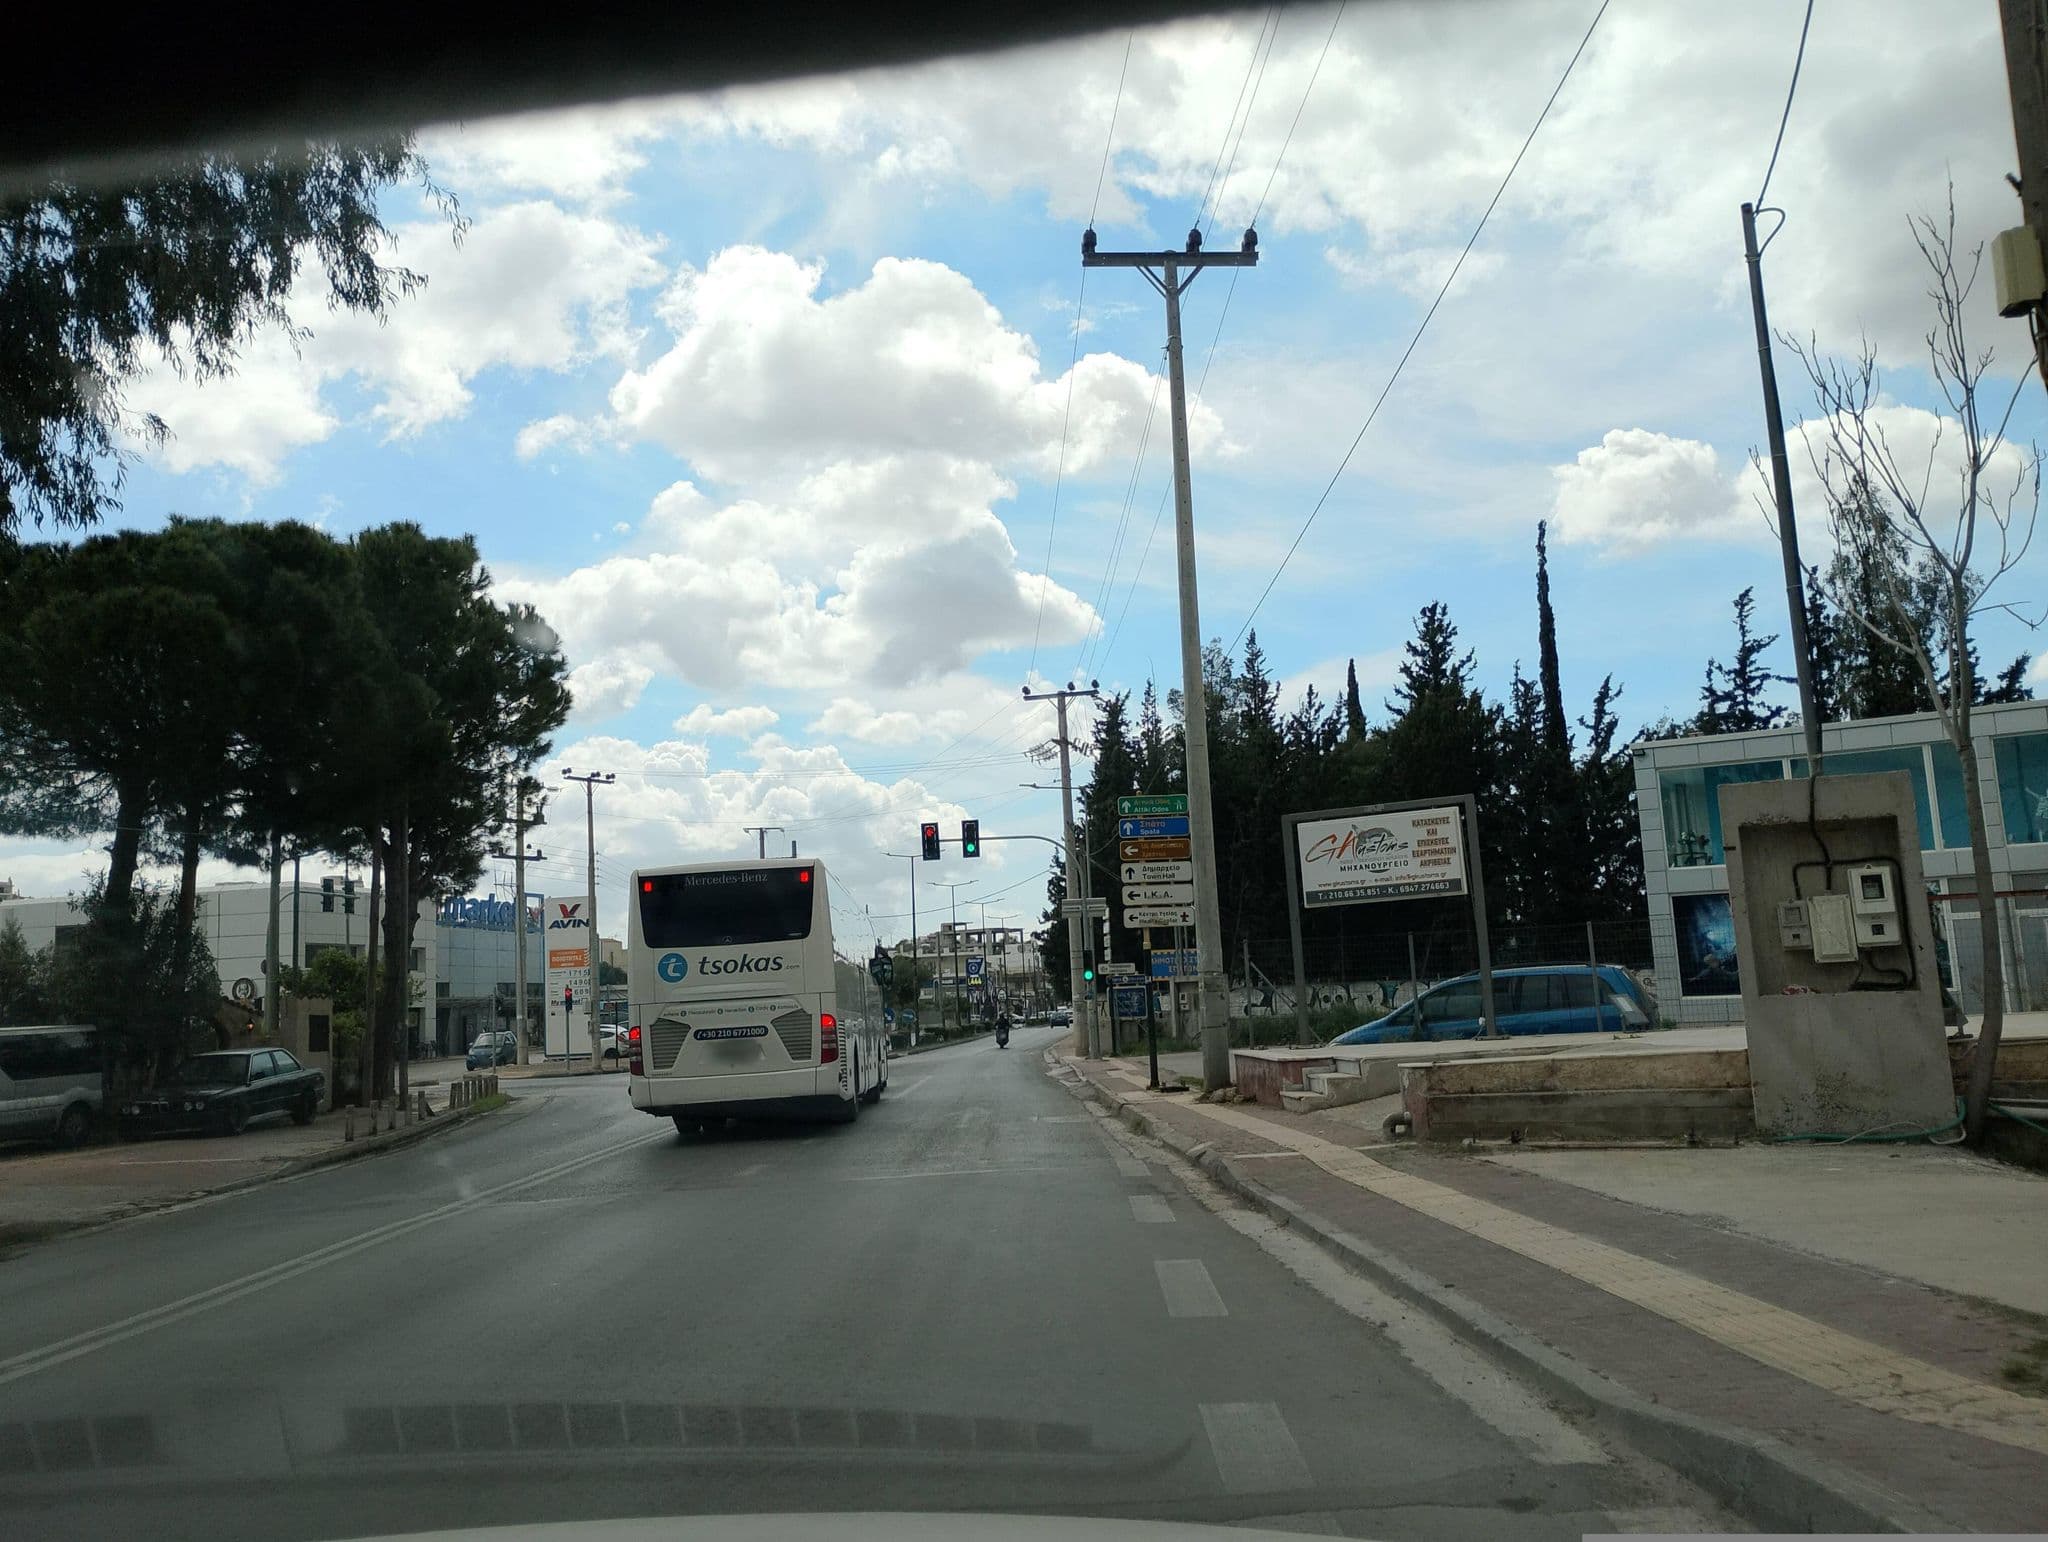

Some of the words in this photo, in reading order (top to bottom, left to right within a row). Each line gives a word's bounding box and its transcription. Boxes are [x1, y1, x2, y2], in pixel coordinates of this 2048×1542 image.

[1412, 816, 1451, 827] ΚΑΤΑΣΚΕΥΕΣ
[1426, 828, 1438, 836] ΚΑΙ
[1417, 837, 1450, 847] ΕΠΙΣΚΕΥΕΣ
[1412, 846, 1457, 857] ΕΞΑΡΤΗΜΑΤΩΝ
[1340, 860, 1409, 872] ΜΗΧΑΝΟΥΡΓΕΙΟ
[1420, 857, 1452, 867] ΑΚΡΙΒΕΙΑΣ
[685, 873, 768, 886] Mercedes-Benz
[548, 918, 590, 930] AVIN
[699, 953, 784, 975] tsokas
[717, 1029, 732, 1038] 210
[732, 1027, 765, 1037] 6771000
